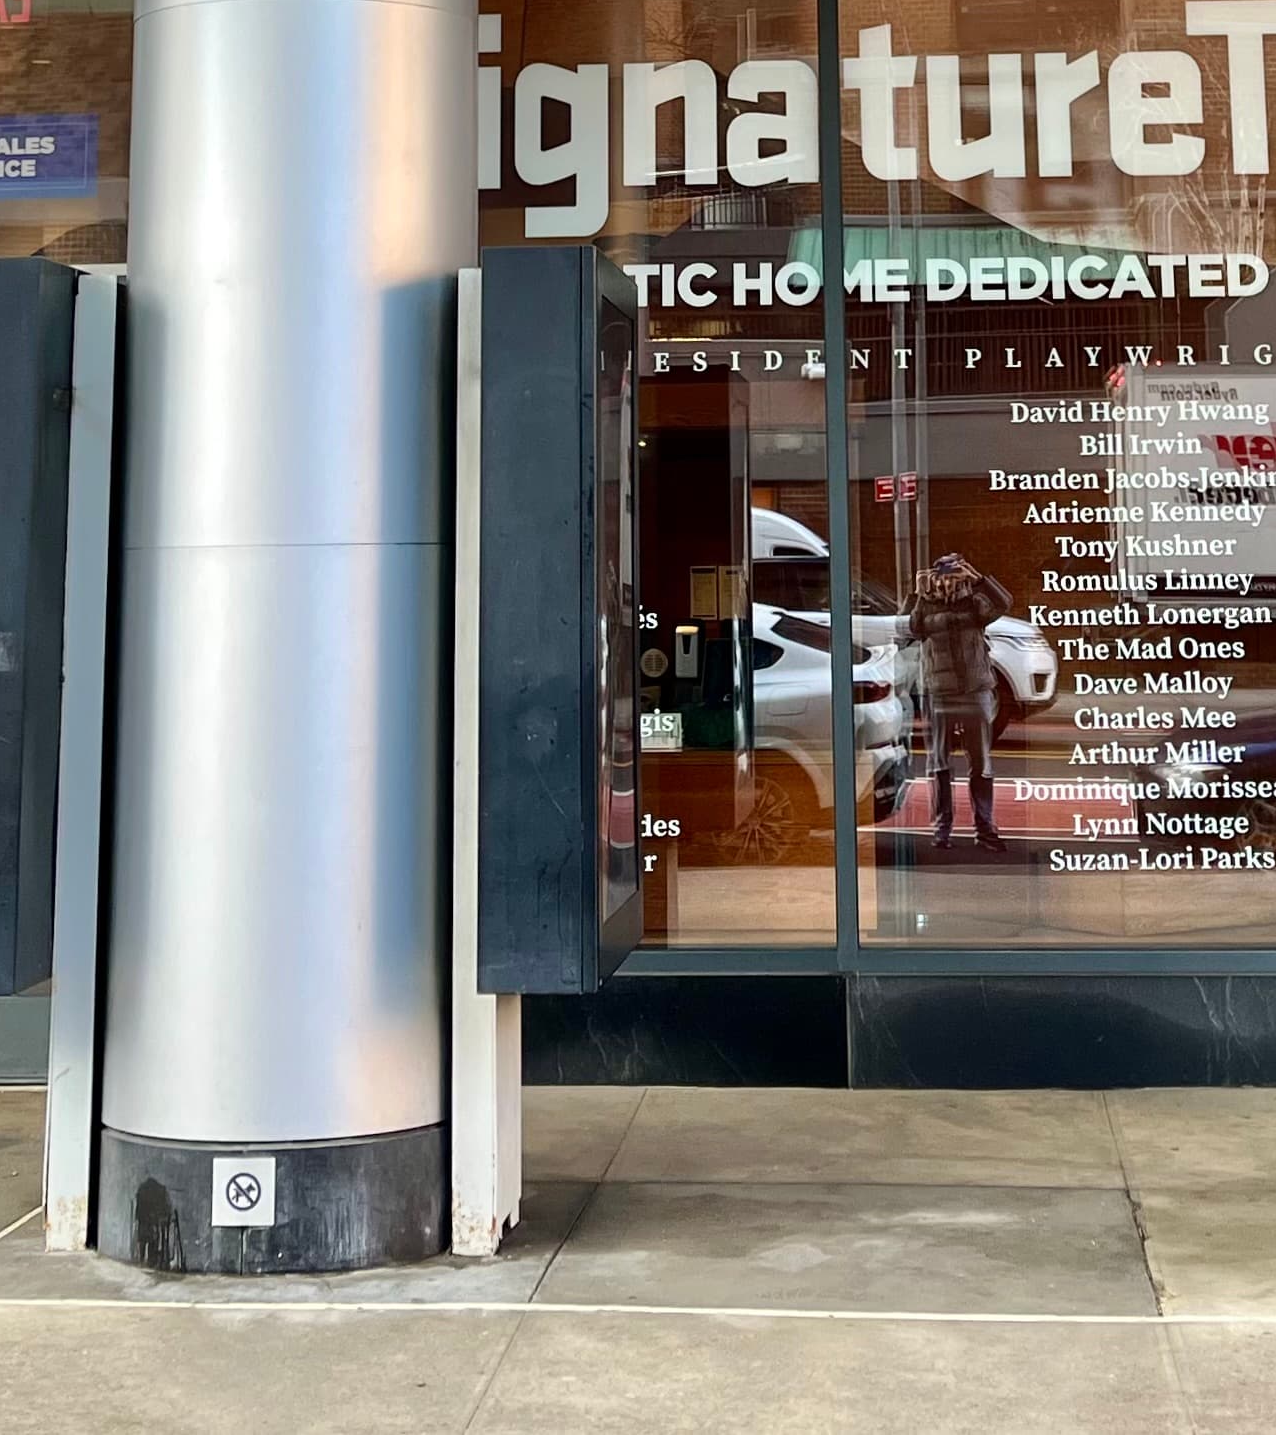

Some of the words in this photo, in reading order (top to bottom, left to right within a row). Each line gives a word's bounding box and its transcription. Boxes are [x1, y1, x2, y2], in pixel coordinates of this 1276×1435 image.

[623, 261, 718, 308] TIC
[733, 257, 910, 307] HOME
[925, 252, 1270, 304] DEDICATED
[653, 348, 913, 373] ESIDENT
[1011, 402, 1083, 424] David
[1089, 401, 1172, 427] Henry
[1178, 400, 1269, 425] Hwang
[1080, 433, 1124, 456] Bill
[1130, 433, 1202, 455] Irwin
[989, 469, 1099, 491] Branden
[1023, 502, 1143, 524] Adrienne
[1152, 501, 1265, 527] Kennedy
[1056, 536, 1119, 562] Tony
[1126, 535, 1237, 557] Kushner
[1042, 570, 1158, 593] Romulus
[1165, 569, 1254, 595] Linney
[1029, 604, 1141, 626] Kenneth
[1146, 604, 1272, 630] Lonergan
[1058, 639, 1109, 661] The
[1116, 638, 1172, 660] Mad
[1179, 638, 1245, 659] Ones
[1074, 674, 1137, 695] Dave
[1144, 672, 1233, 698] Malloy
[1074, 707, 1175, 729] Charles
[1181, 707, 1237, 728] Mee
[1068, 743, 1158, 765] Arthur
[1165, 742, 1246, 764] Miller
[1013, 778, 1161, 806] Dominique
[1072, 813, 1139, 840] Lynn
[1145, 812, 1250, 839] Nottage
[1049, 849, 1194, 872] Suzan-Lori
[1200, 847, 1276, 870] Parks
